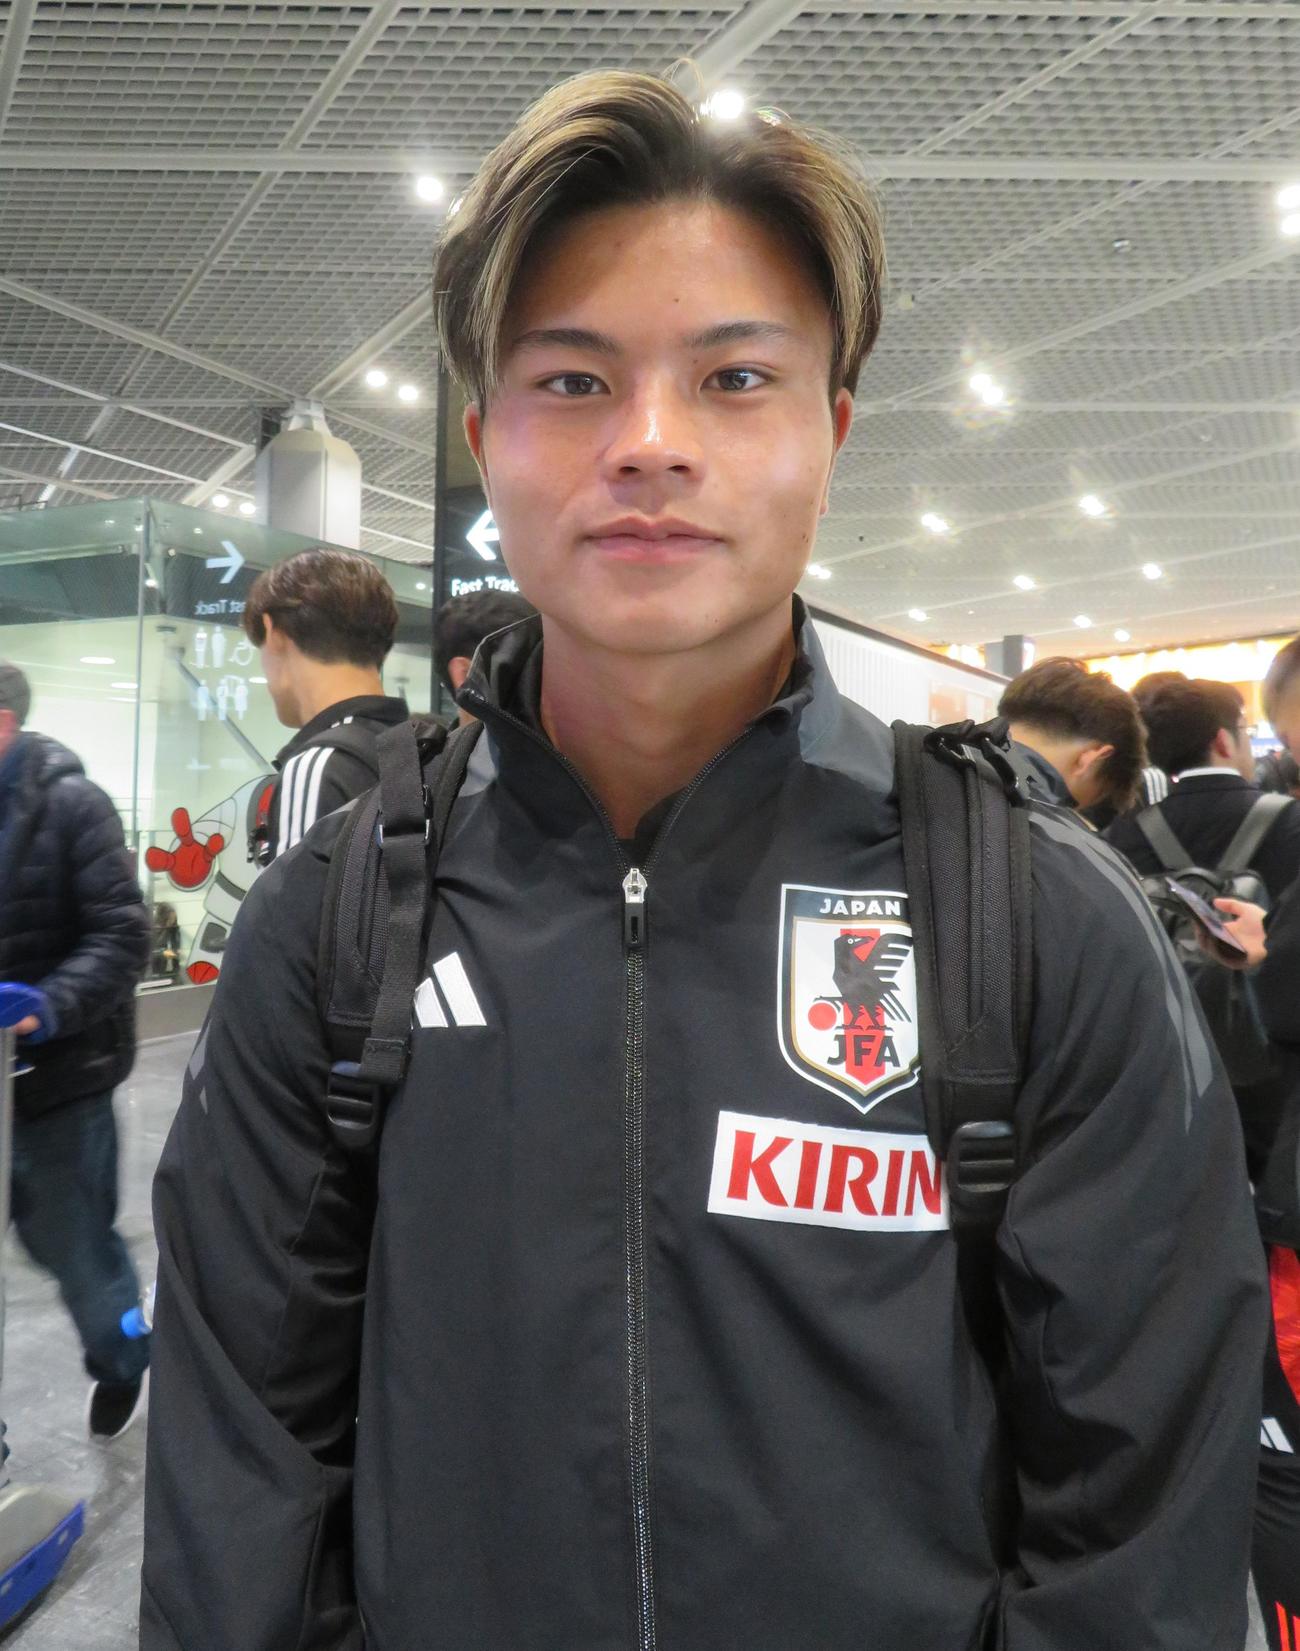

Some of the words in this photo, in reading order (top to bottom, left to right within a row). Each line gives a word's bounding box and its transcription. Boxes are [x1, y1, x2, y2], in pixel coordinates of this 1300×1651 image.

[485, 576, 520, 592] Trac
[819, 898, 901, 916] JAPAN
[827, 1034, 901, 1068] JFA
[726, 1129, 942, 1217] KIRIN
